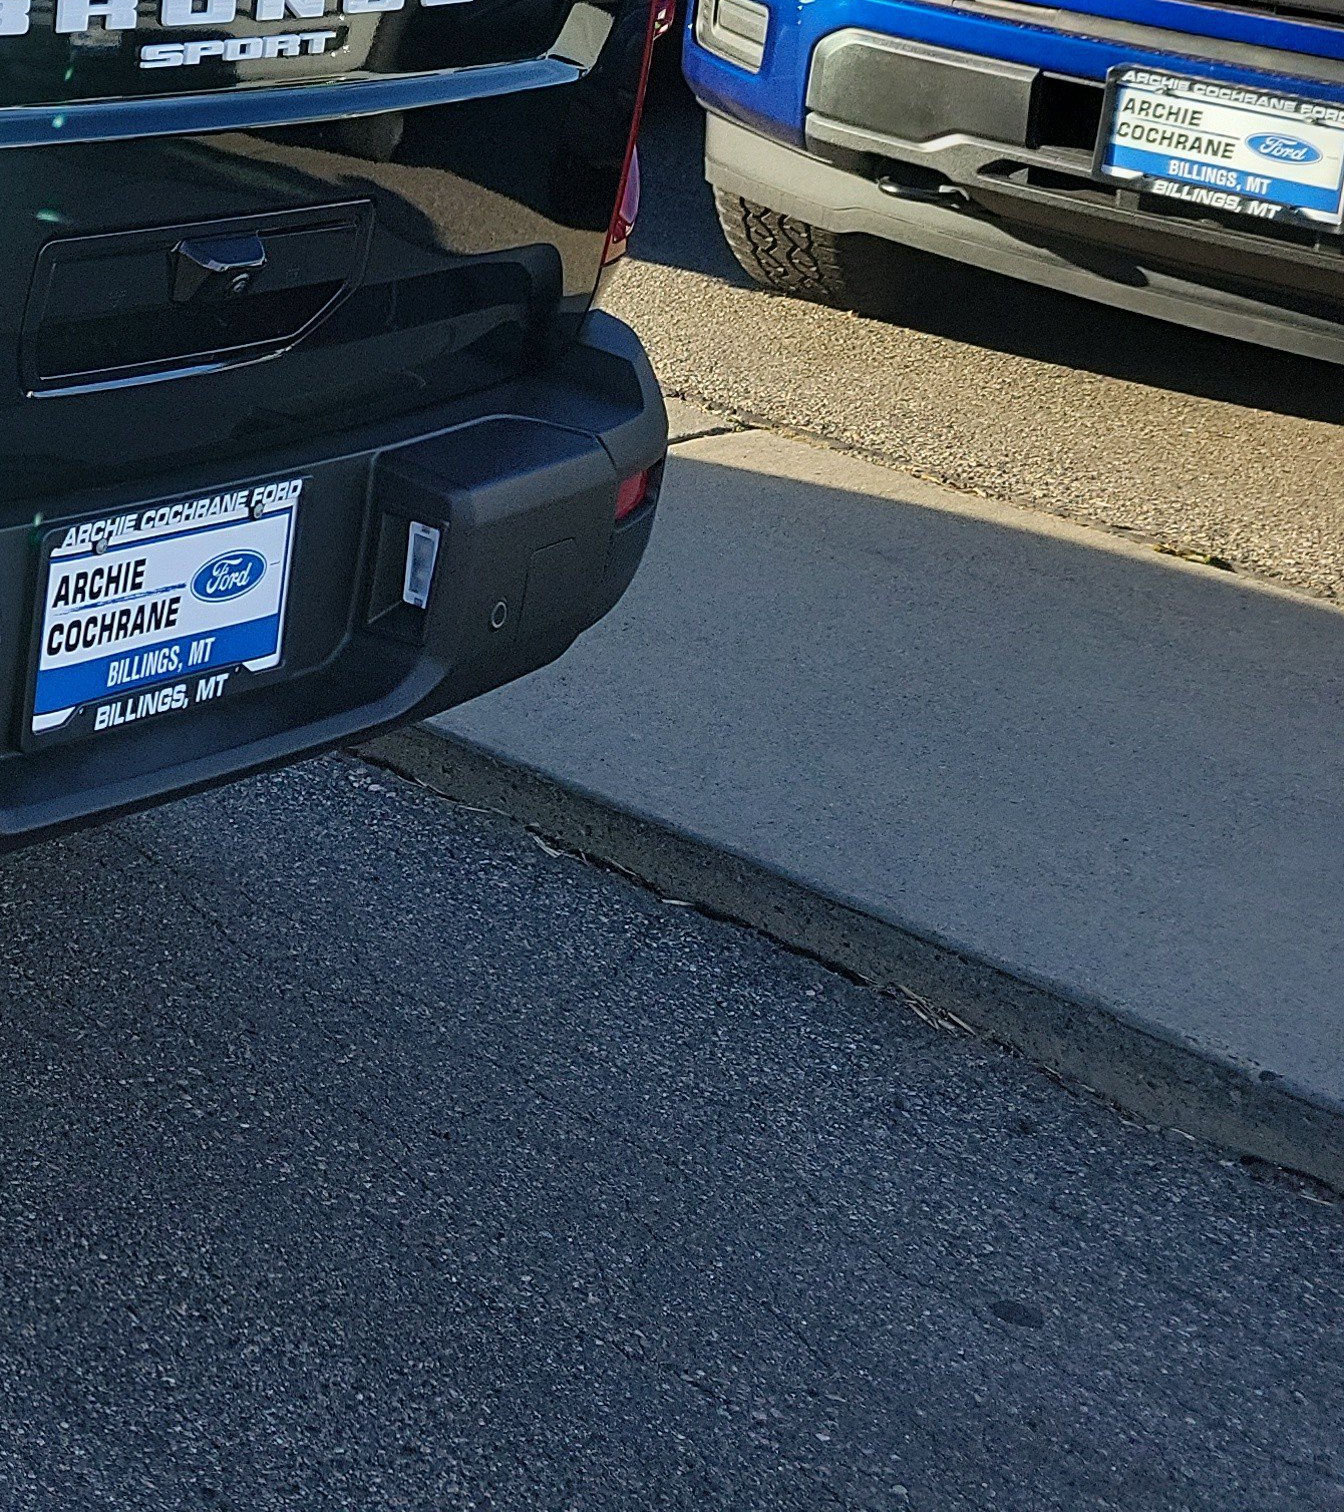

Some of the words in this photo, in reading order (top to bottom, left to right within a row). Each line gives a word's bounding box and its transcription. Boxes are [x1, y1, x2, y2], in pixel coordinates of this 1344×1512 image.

[139, 31, 337, 68] SPORT
[1122, 70, 1190, 91] ARCHIE
[1193, 83, 1297, 113] COCHRANE
[1122, 97, 1203, 127] ARCHIE
[1117, 121, 1236, 160] COCHRANE
[1258, 136, 1309, 162] Ford
[1168, 159, 1242, 190] BILLINGS,
[1246, 176, 1272, 195] MT
[1152, 180, 1243, 213] BILLINGS,
[1247, 199, 1282, 219] MT
[61, 518, 137, 549] ARCHIE
[140, 491, 249, 530] COCHRANE
[250, 479, 303, 507] FORD
[52, 558, 146, 609] ARCHIE
[206, 558, 251, 595] Ford
[46, 596, 181, 656] COCHRANE
[107, 646, 183, 688] BILLINGS,
[188, 637, 215, 664] MT
[94, 683, 189, 731] BILLINGS,
[195, 673, 229, 703] MT
